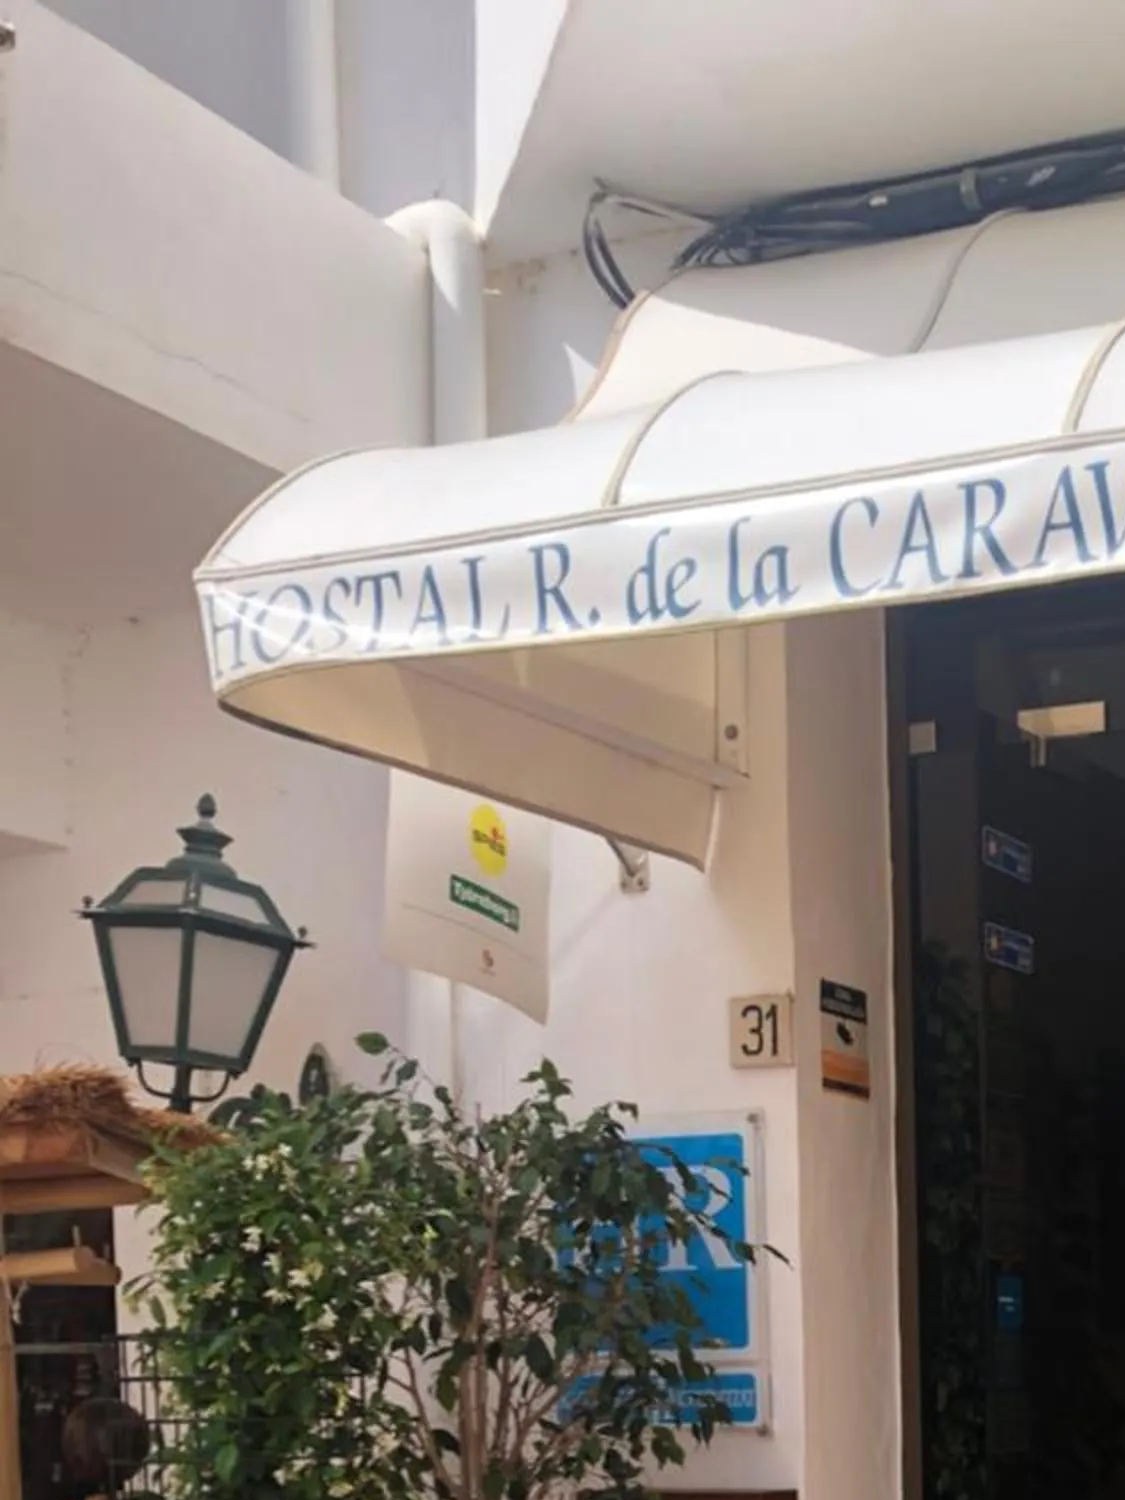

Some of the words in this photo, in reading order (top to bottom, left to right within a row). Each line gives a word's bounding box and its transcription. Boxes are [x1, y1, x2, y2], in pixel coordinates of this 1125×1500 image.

[203, 556, 511, 679] HOSTAL
[529, 541, 601, 636] R.
[625, 527, 700, 627] de
[726, 516, 799, 612] la
[740, 1003, 778, 1057] 31
